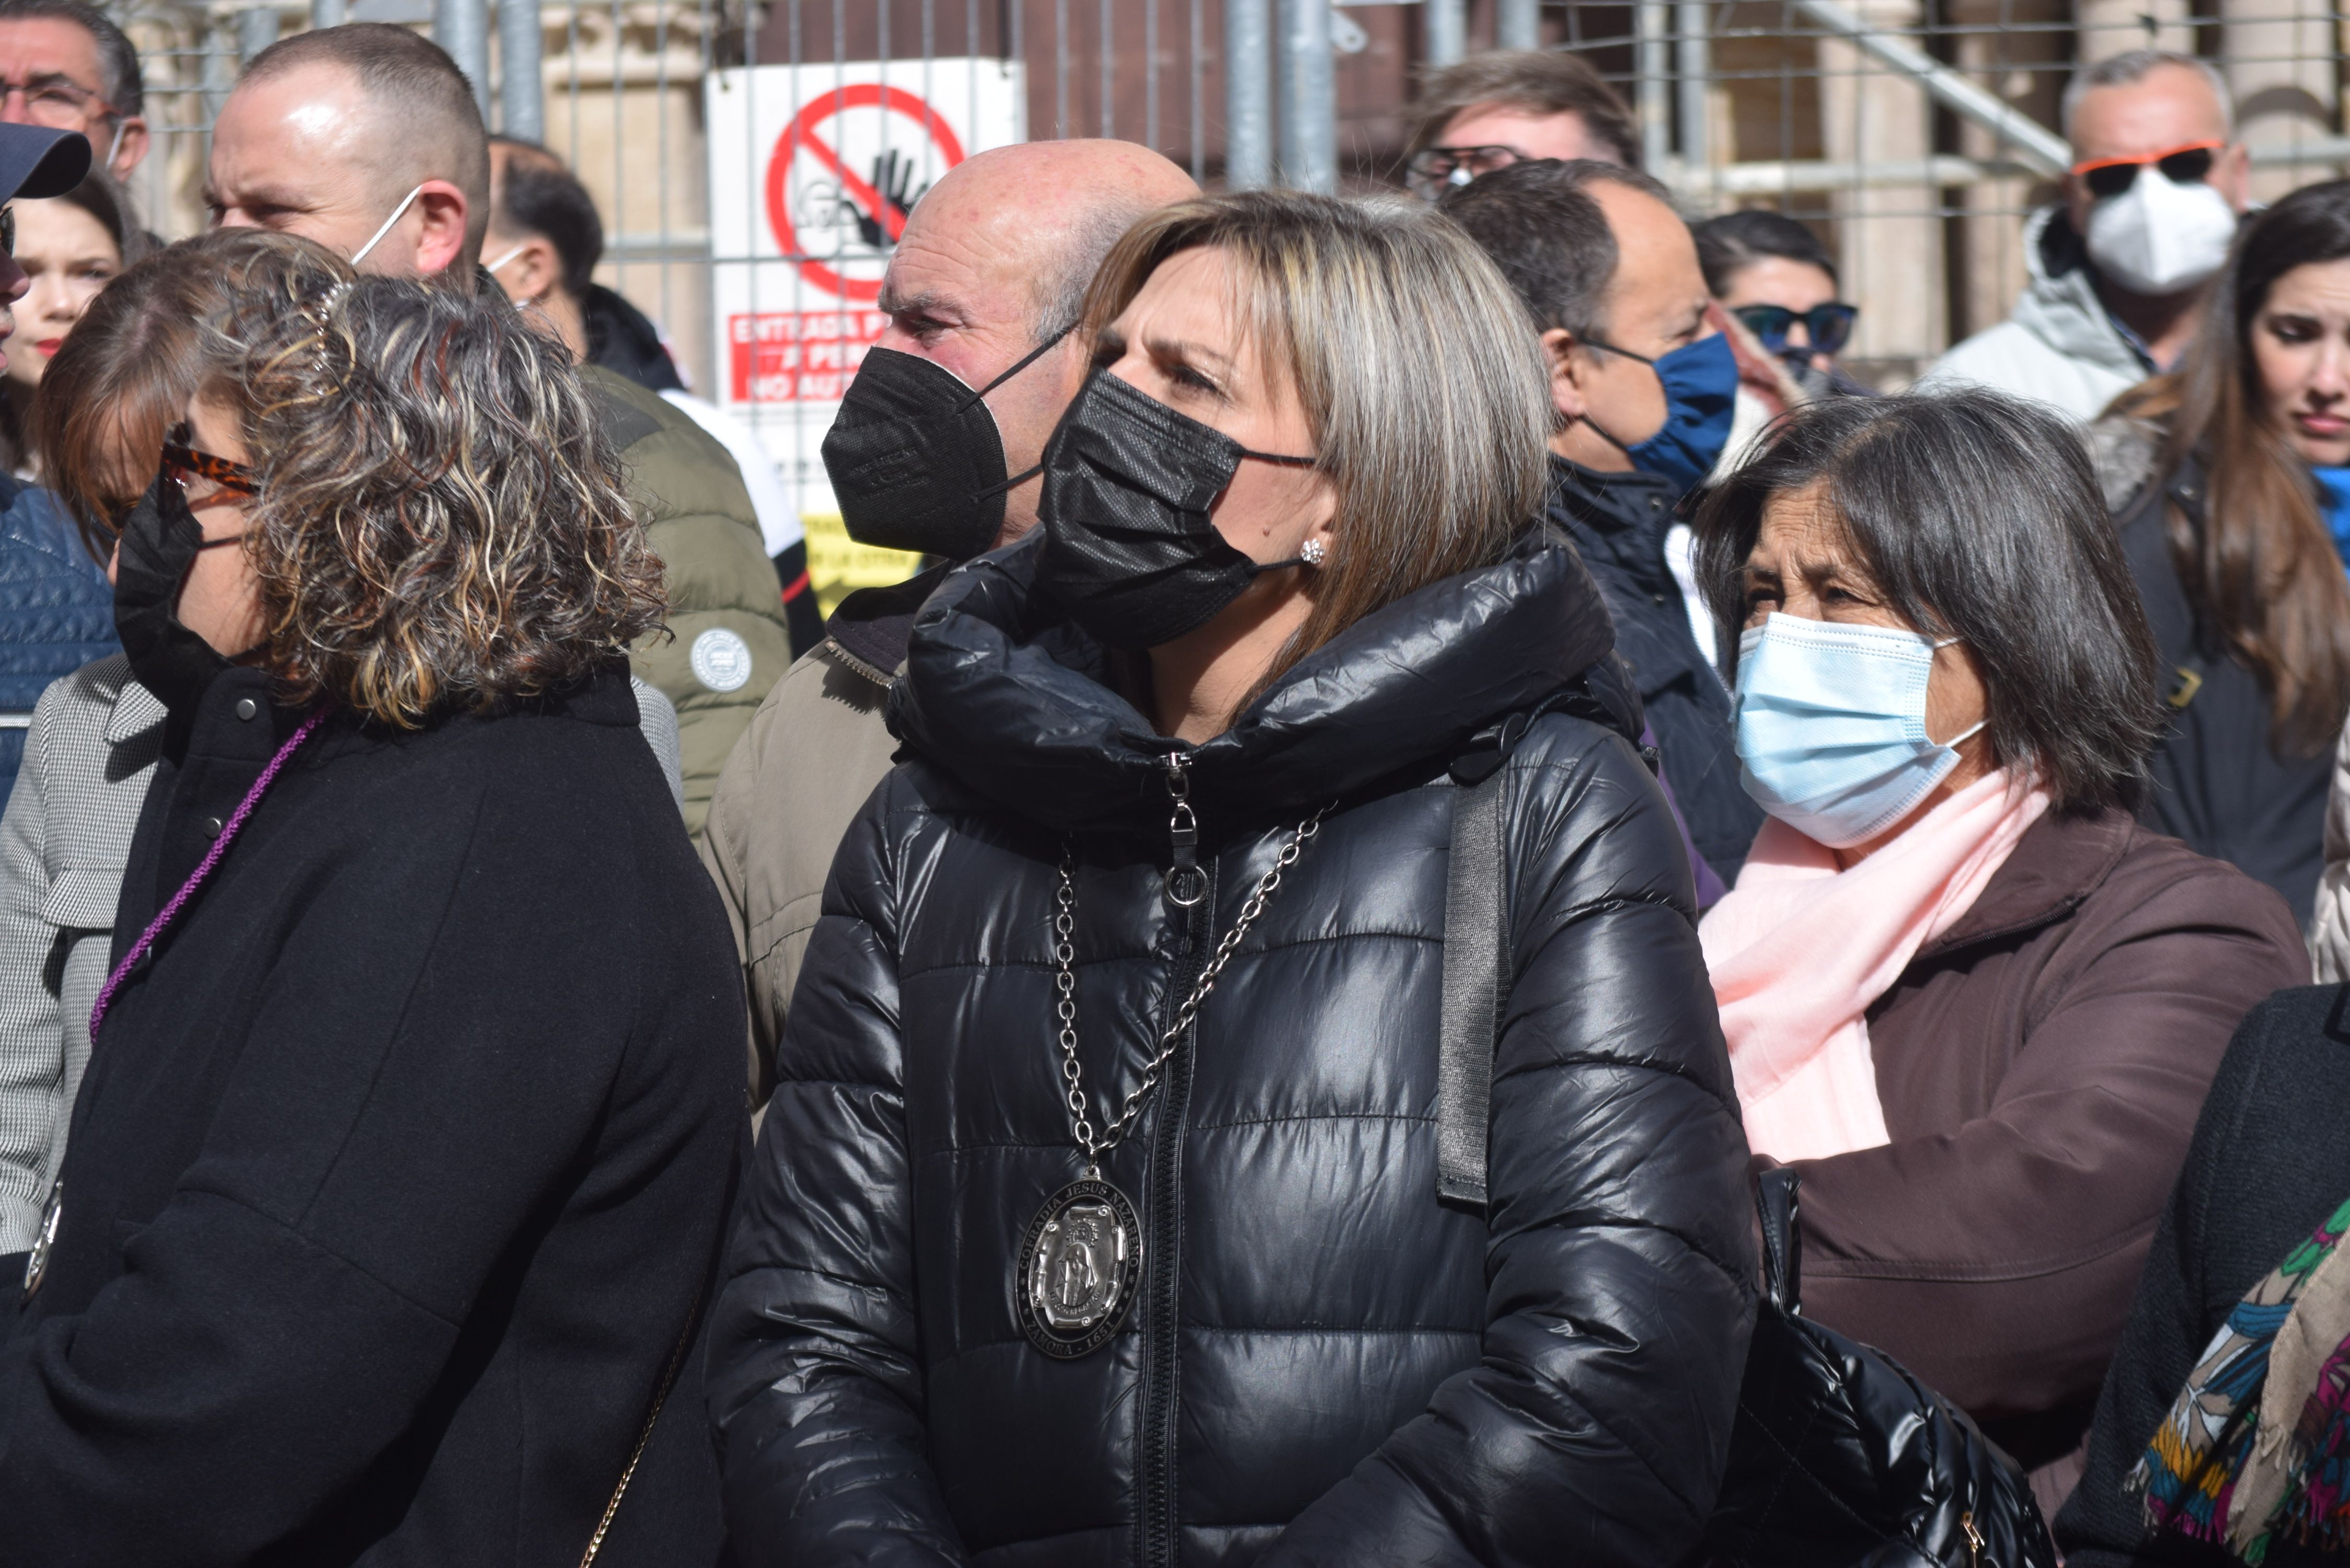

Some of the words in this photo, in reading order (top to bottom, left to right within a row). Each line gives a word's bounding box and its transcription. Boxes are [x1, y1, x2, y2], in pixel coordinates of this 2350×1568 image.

[734, 314, 859, 343] ENTRADA
[750, 374, 792, 399] NO
[1020, 1197, 1062, 1270] COFRADIA
[1066, 1184, 1108, 1198] JESUS
[1110, 1191, 1139, 1268] NAZARENO
[1027, 1321, 1072, 1355] ZAMORA
[1086, 1321, 1114, 1348] 1651
